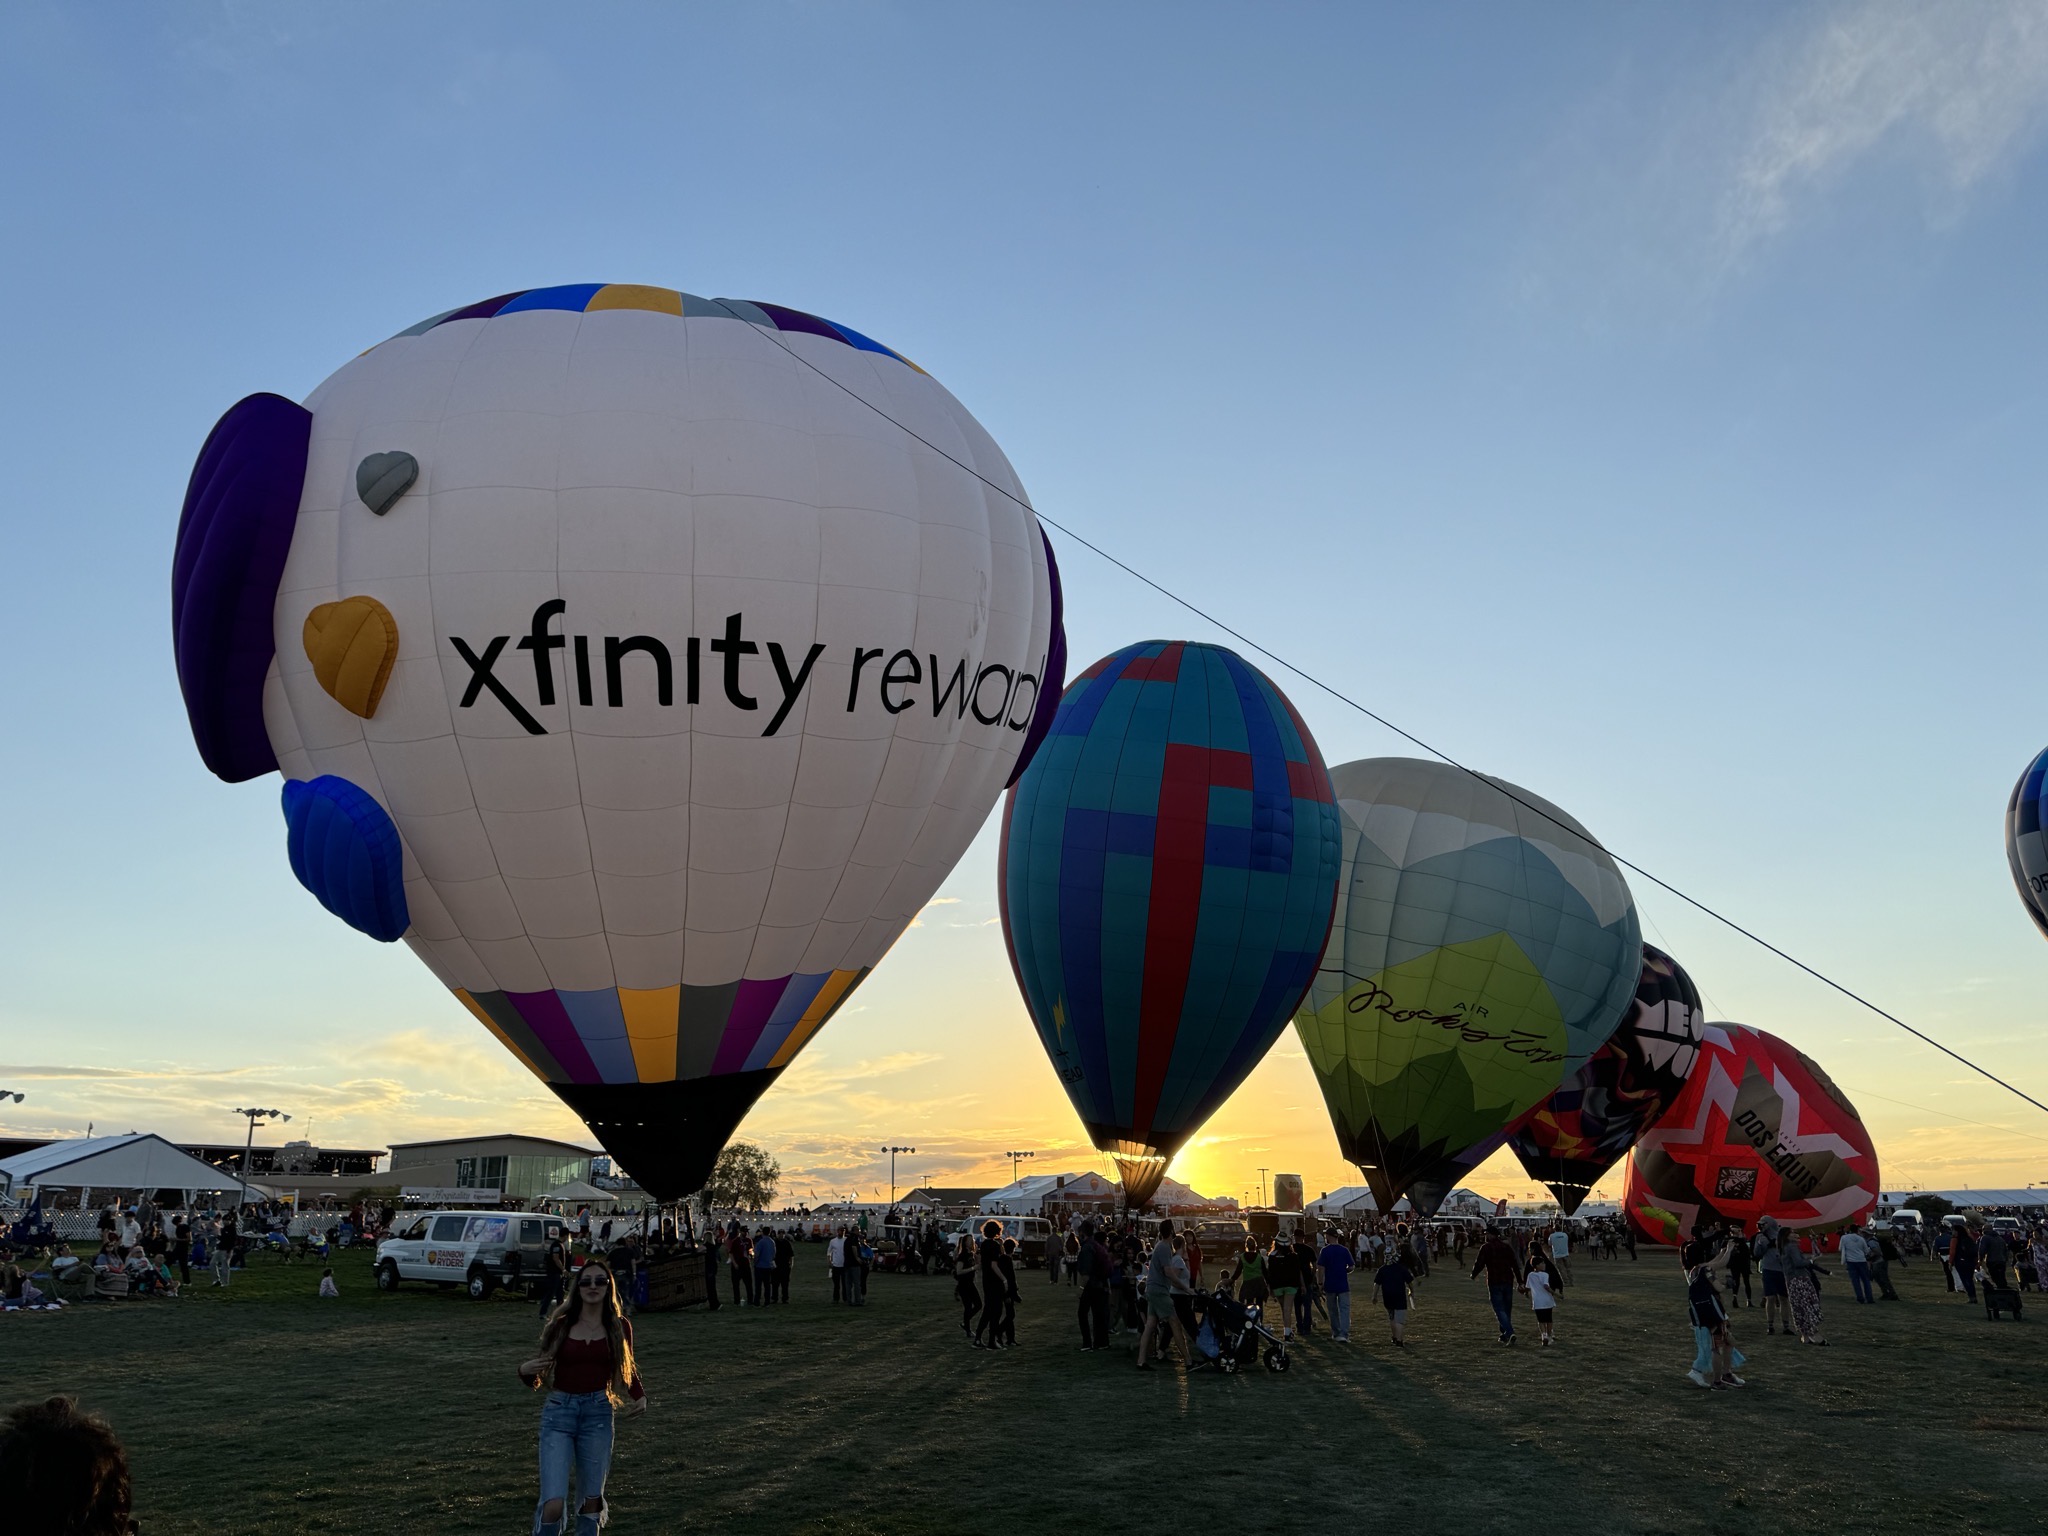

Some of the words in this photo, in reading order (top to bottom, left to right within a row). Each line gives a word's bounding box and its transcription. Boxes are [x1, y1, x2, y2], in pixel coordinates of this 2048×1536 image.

[449, 599, 826, 737] xfinity
[846, 646, 1046, 733] reward
[1453, 1002, 1489, 1019] AIR
[1735, 1110, 1773, 1148] DOS
[1765, 1143, 1818, 1194] EQUIS
[522, 1221, 529, 1229] 22
[437, 1250, 465, 1258] RAINBOW
[437, 1258, 464, 1267] RYDERS
